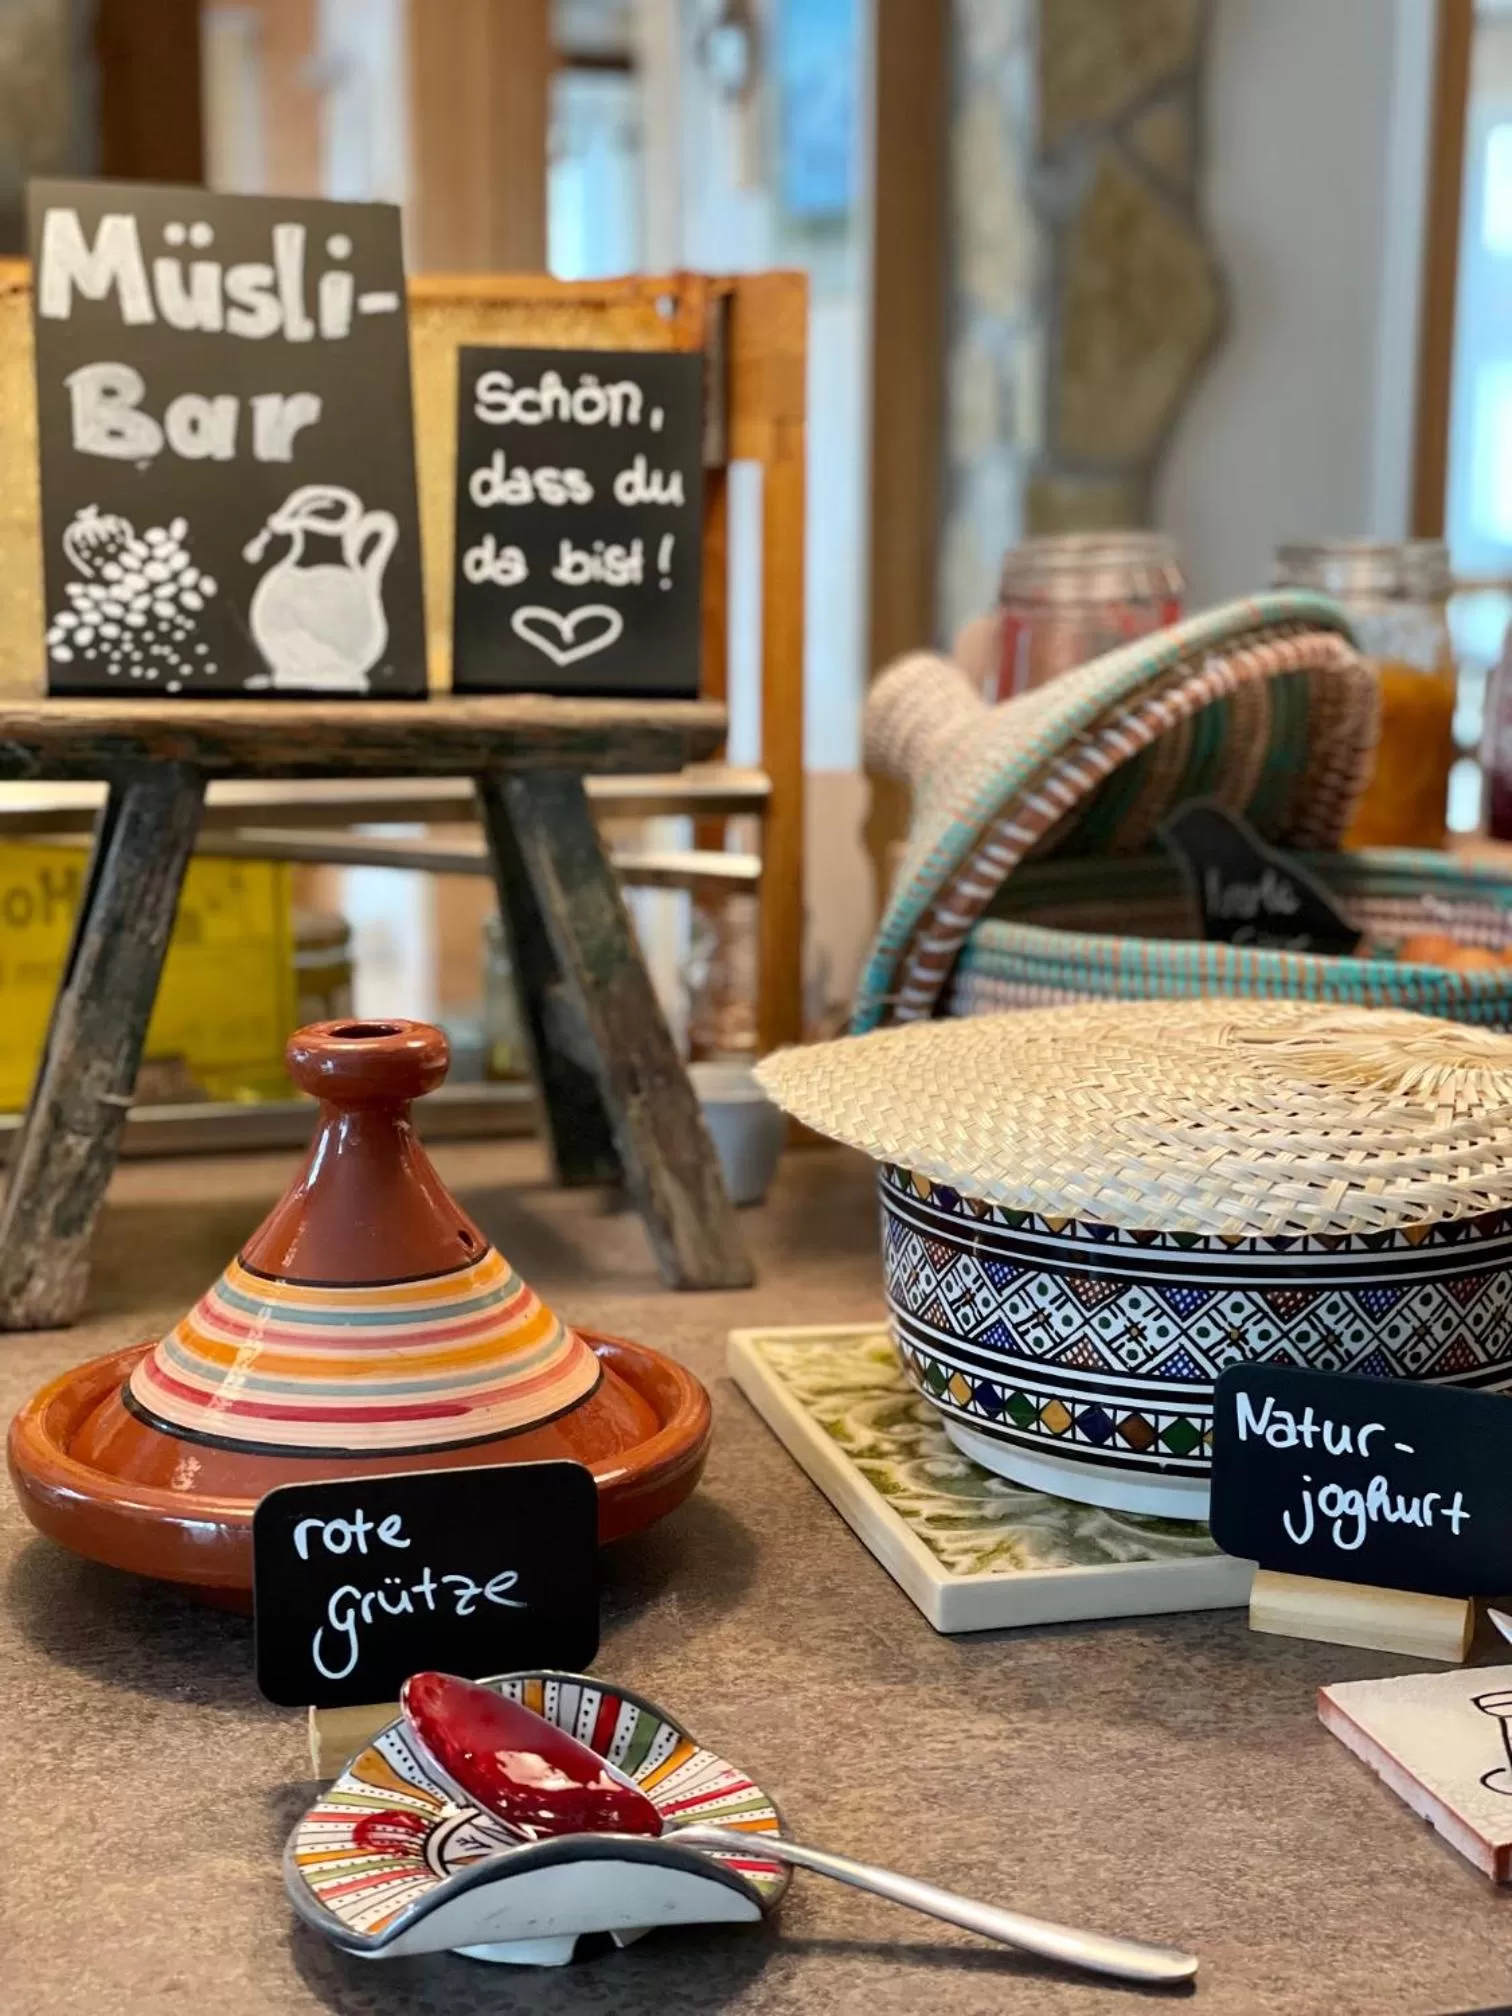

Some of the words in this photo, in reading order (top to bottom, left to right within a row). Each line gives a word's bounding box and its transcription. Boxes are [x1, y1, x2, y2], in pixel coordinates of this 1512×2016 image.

[39, 208, 400, 342] Müsli-
[63, 361, 322, 464] Bar
[473, 369, 665, 433] Schön,
[468, 448, 595, 508] dass
[612, 452, 686, 508] du
[462, 531, 530, 588] da
[1235, 1391, 1415, 1457] Natur-
[293, 1508, 411, 1560] rote
